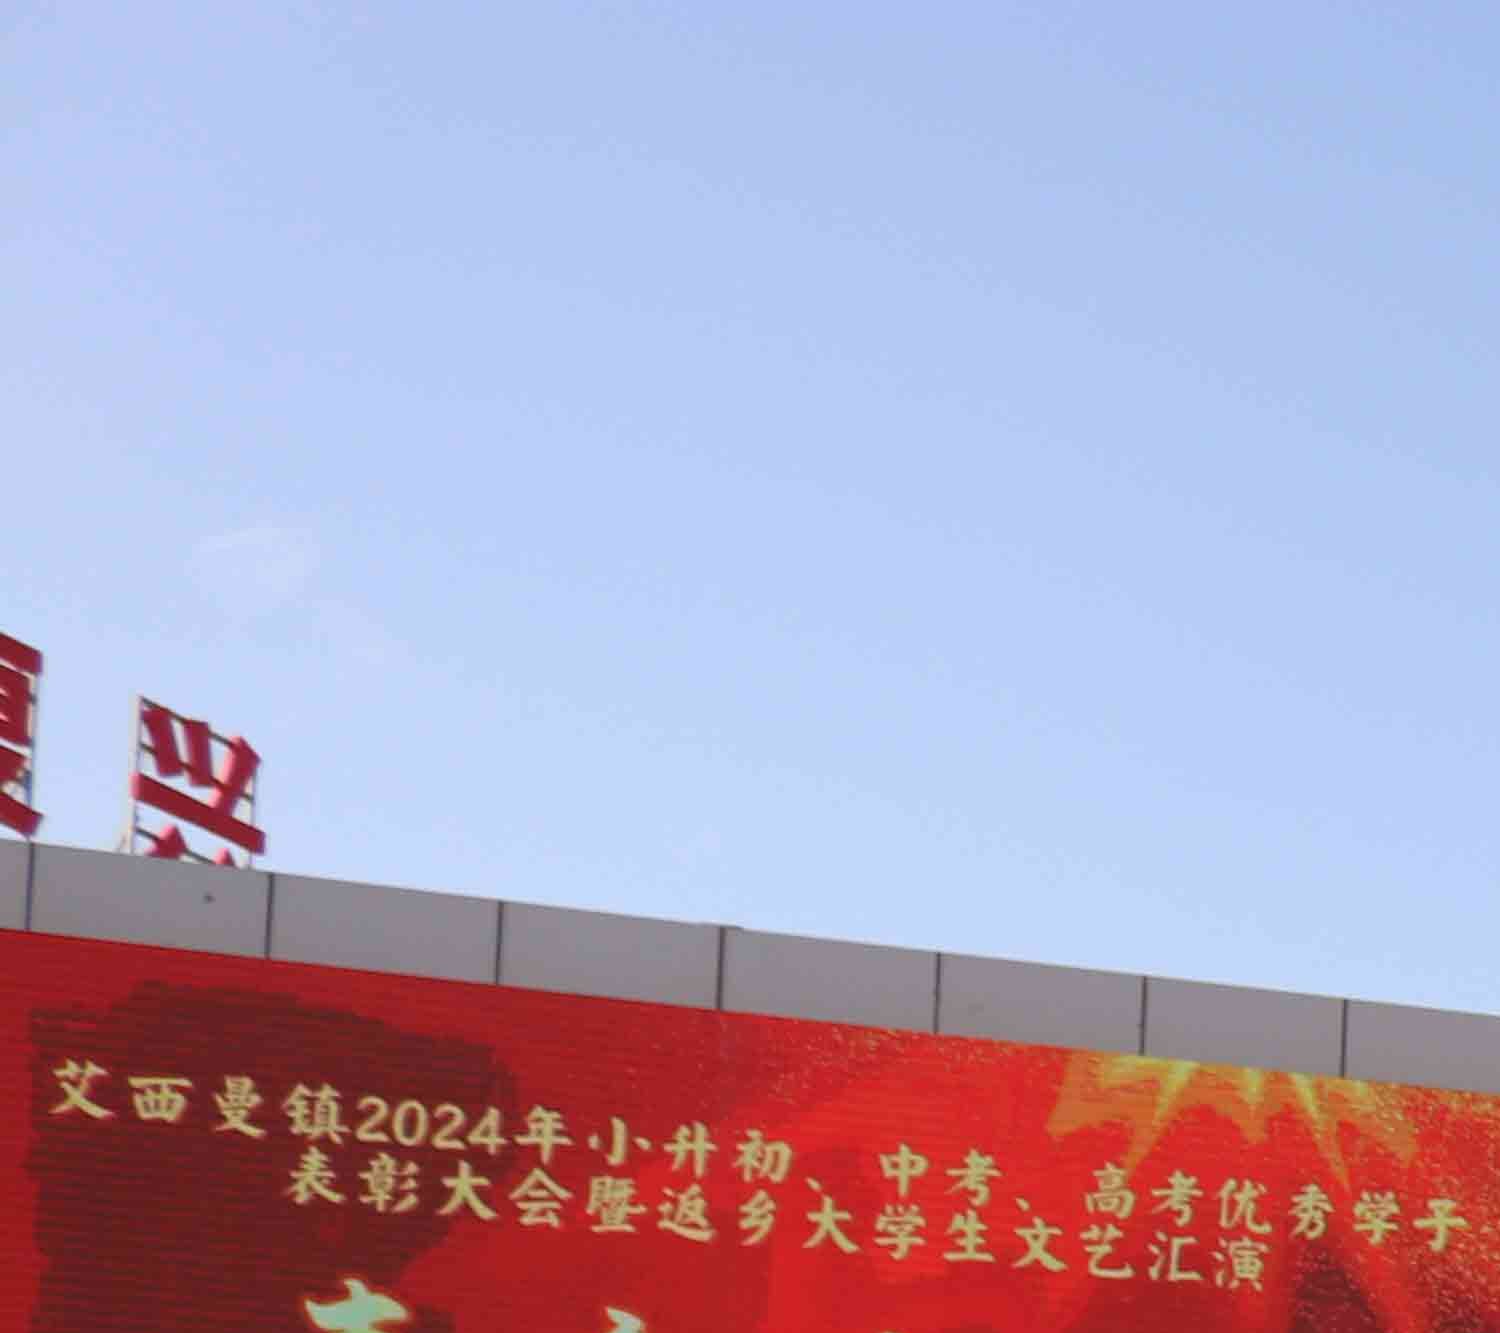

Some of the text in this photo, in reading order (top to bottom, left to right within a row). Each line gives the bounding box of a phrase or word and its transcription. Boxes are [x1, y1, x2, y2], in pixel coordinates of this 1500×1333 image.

[288, 1146, 1265, 1293] 表彰大会暨返乡大学生文艺汇演
